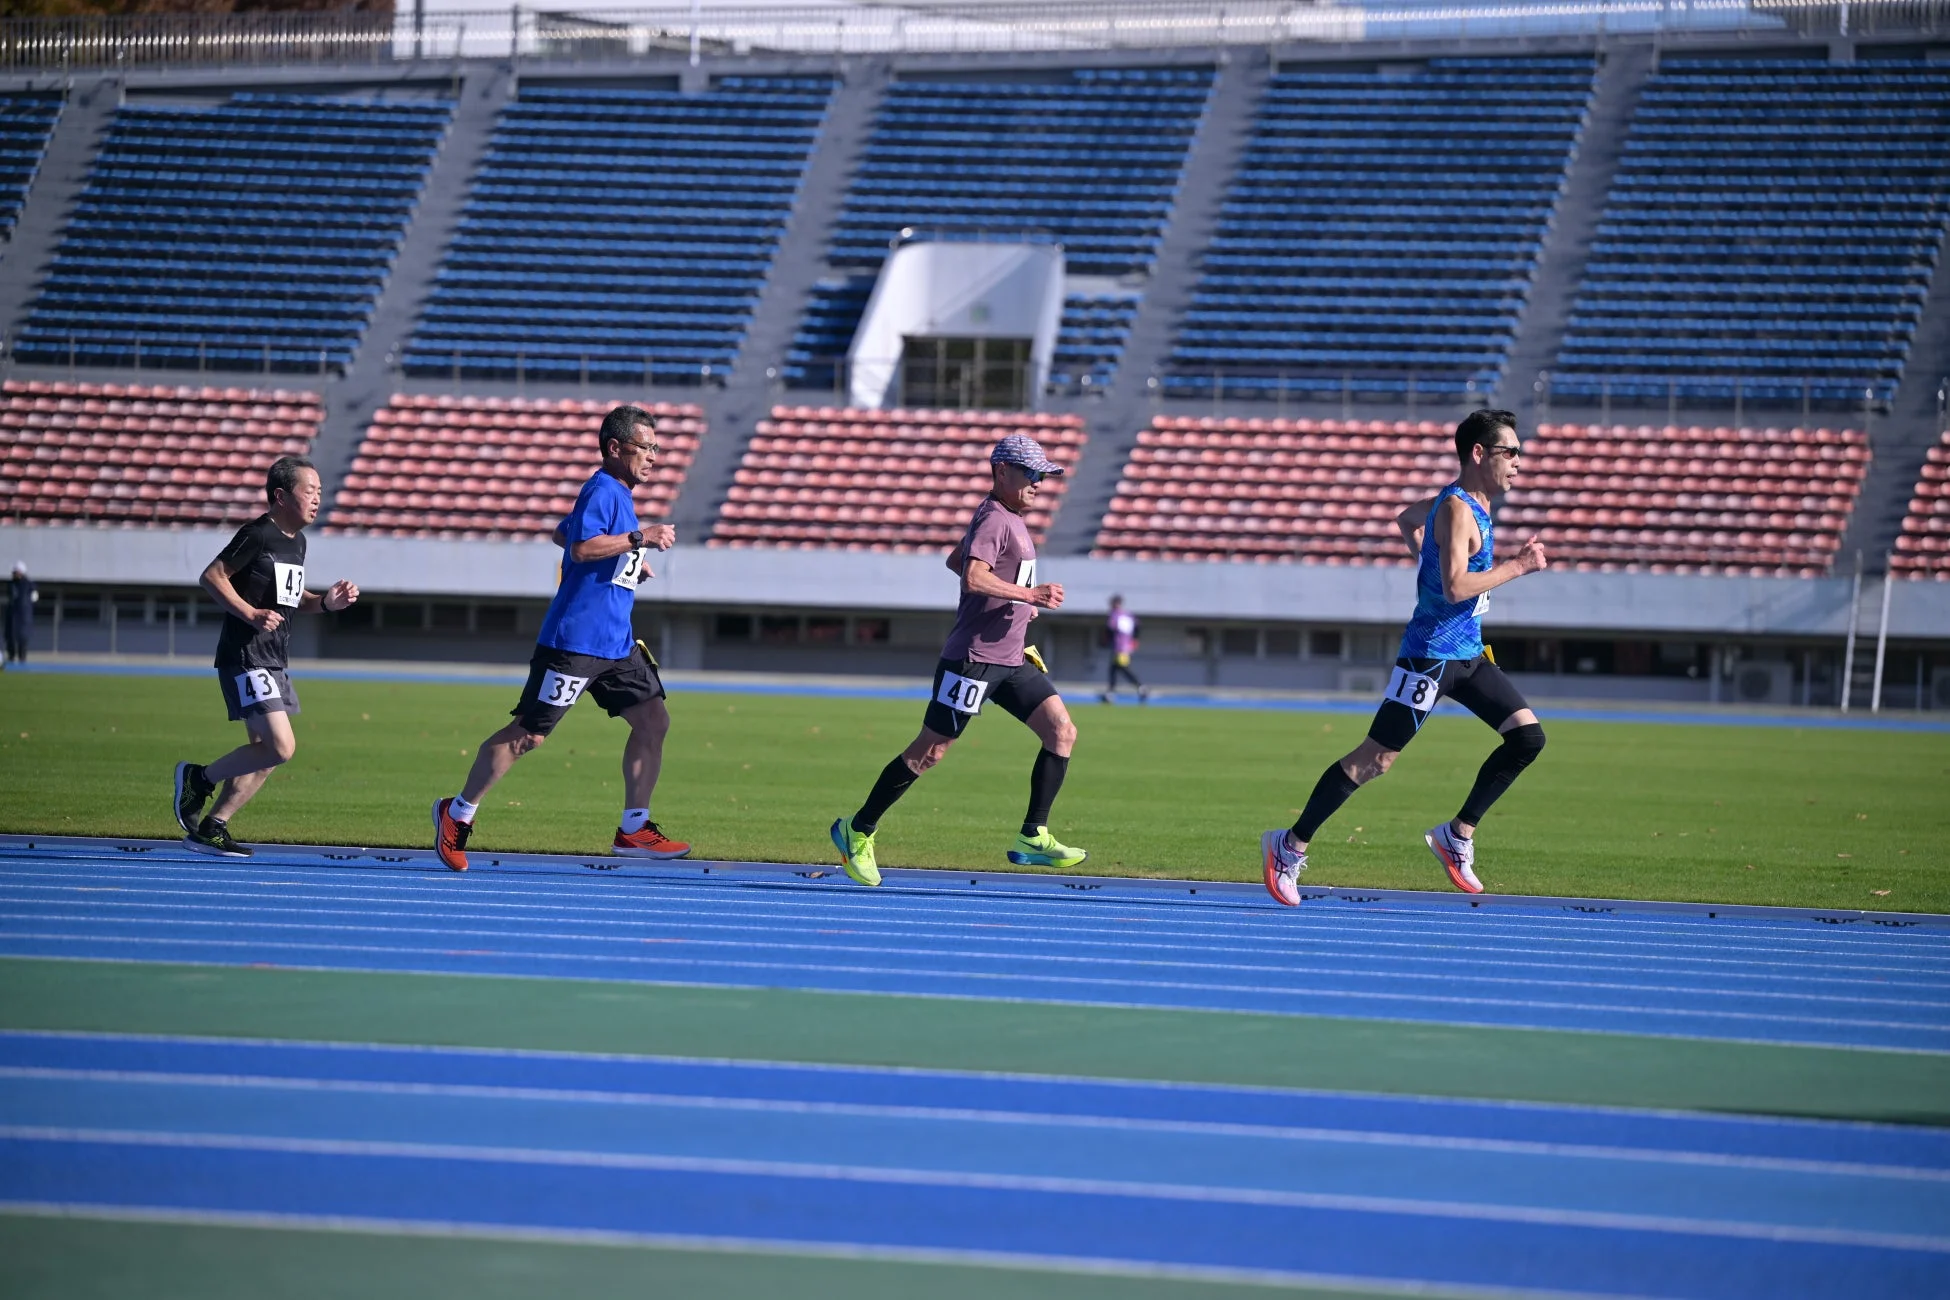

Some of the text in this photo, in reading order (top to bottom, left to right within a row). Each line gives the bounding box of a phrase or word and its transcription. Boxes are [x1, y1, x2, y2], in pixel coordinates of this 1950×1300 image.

[625, 550, 645, 577] 3
[286, 569, 303, 597] 43
[246, 672, 273, 700] 43
[548, 677, 580, 703] 35
[947, 680, 979, 708] 40
[1395, 673, 1429, 704] 18
